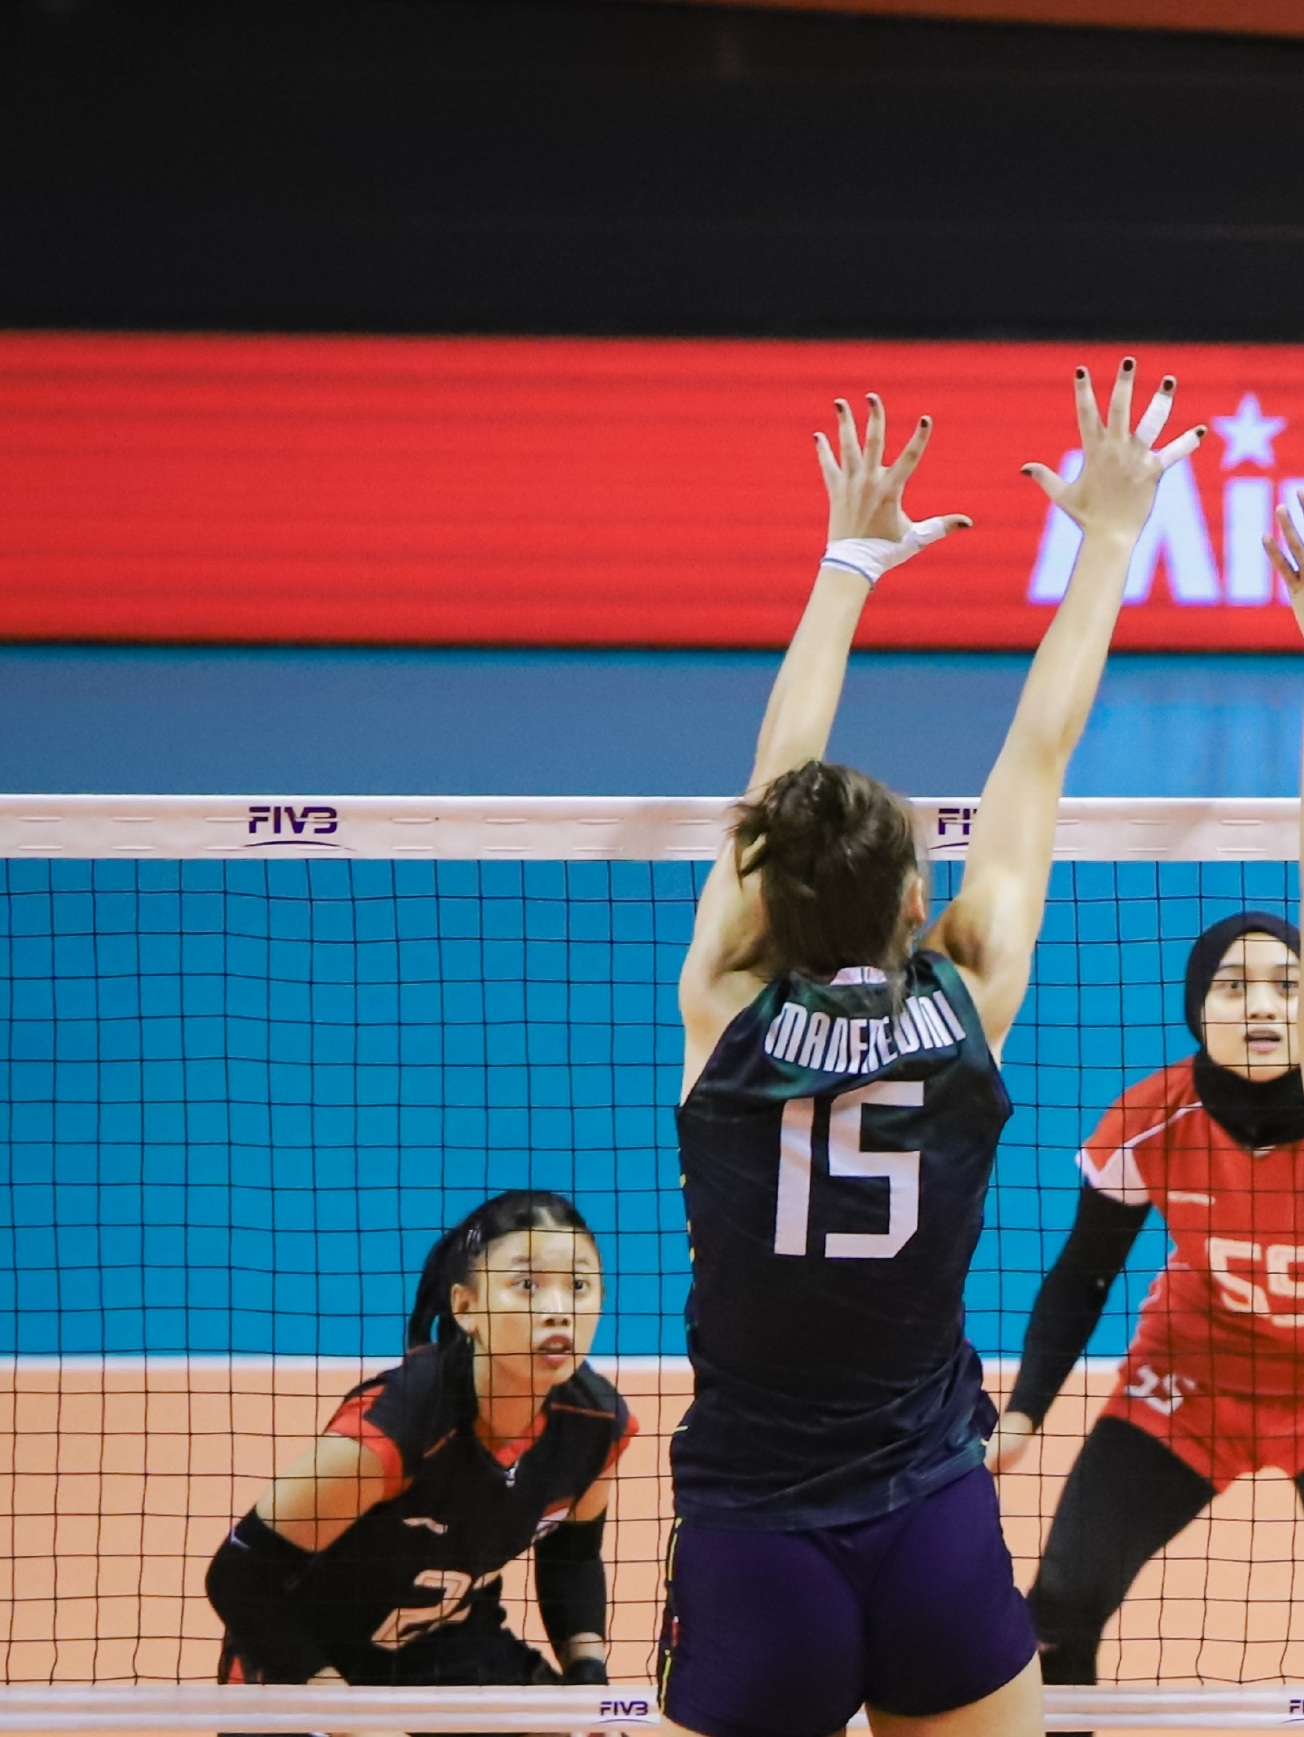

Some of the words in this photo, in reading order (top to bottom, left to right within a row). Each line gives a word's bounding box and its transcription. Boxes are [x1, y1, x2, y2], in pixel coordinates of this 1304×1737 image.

[248, 806, 338, 835] FIVB
[938, 808, 978, 835] FI
[774, 1080, 925, 1259] 15
[600, 1700, 649, 1716] FIVB
